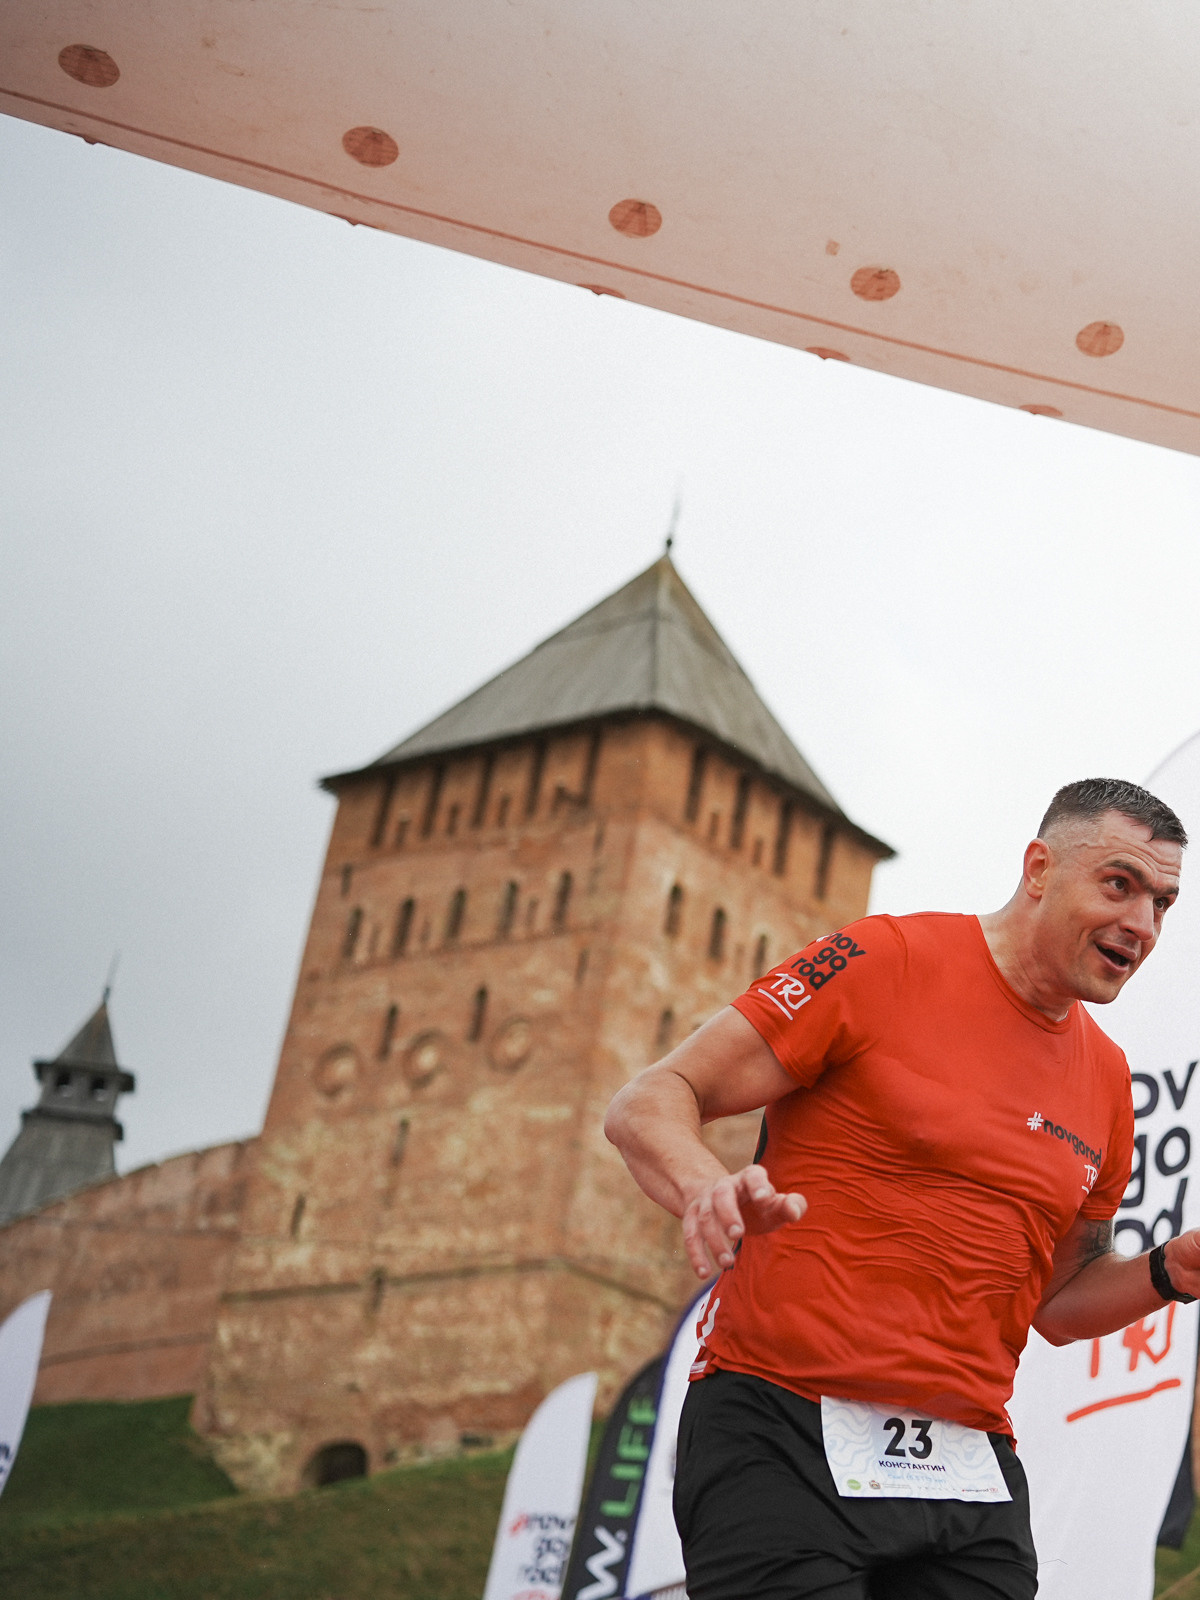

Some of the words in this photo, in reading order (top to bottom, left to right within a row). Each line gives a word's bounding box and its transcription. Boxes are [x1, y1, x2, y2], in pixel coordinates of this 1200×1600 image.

[812, 946, 848, 972] go
[818, 932, 867, 958] nov
[769, 972, 812, 1011] TRI
[790, 957, 837, 991] rod
[1131, 1061, 1199, 1120] ov
[1026, 1111, 1102, 1170] #novgorod
[1084, 1164, 1099, 1190] TR
[1113, 1177, 1189, 1257] od
[883, 1417, 933, 1460] 23
[878, 1460, 946, 1473] КОНСТАНТИН
